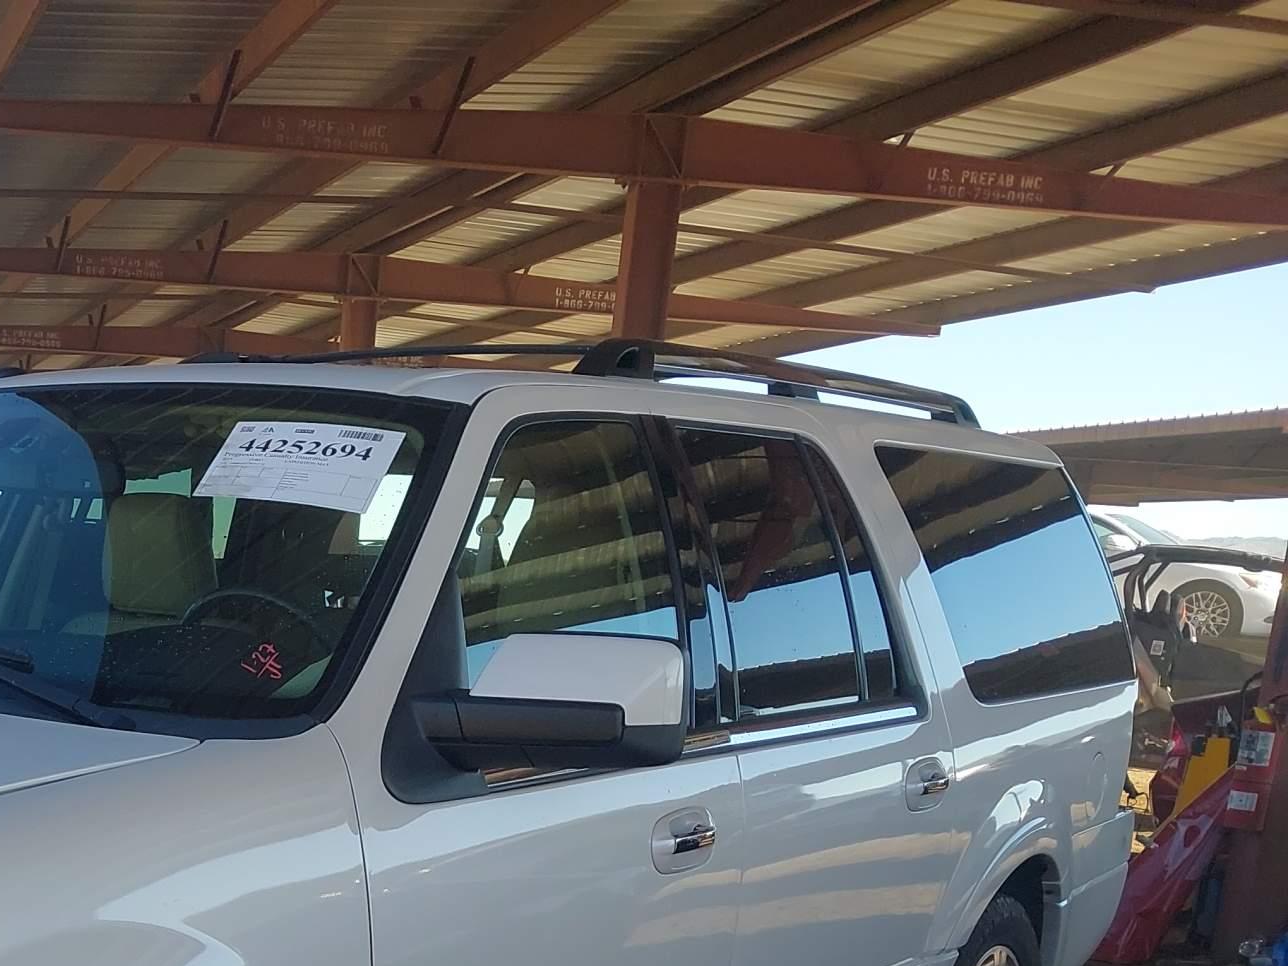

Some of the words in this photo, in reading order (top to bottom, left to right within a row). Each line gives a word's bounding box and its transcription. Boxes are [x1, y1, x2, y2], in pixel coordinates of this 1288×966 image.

[298, 118, 355, 136] PREFB
[926, 167, 954, 183] U.S.
[960, 169, 1015, 189] PREFAB
[1019, 174, 1044, 190] INC
[554, 286, 574, 299] U.S.
[577, 288, 617, 302] PREFAB
[238, 438, 374, 461] 44252694
